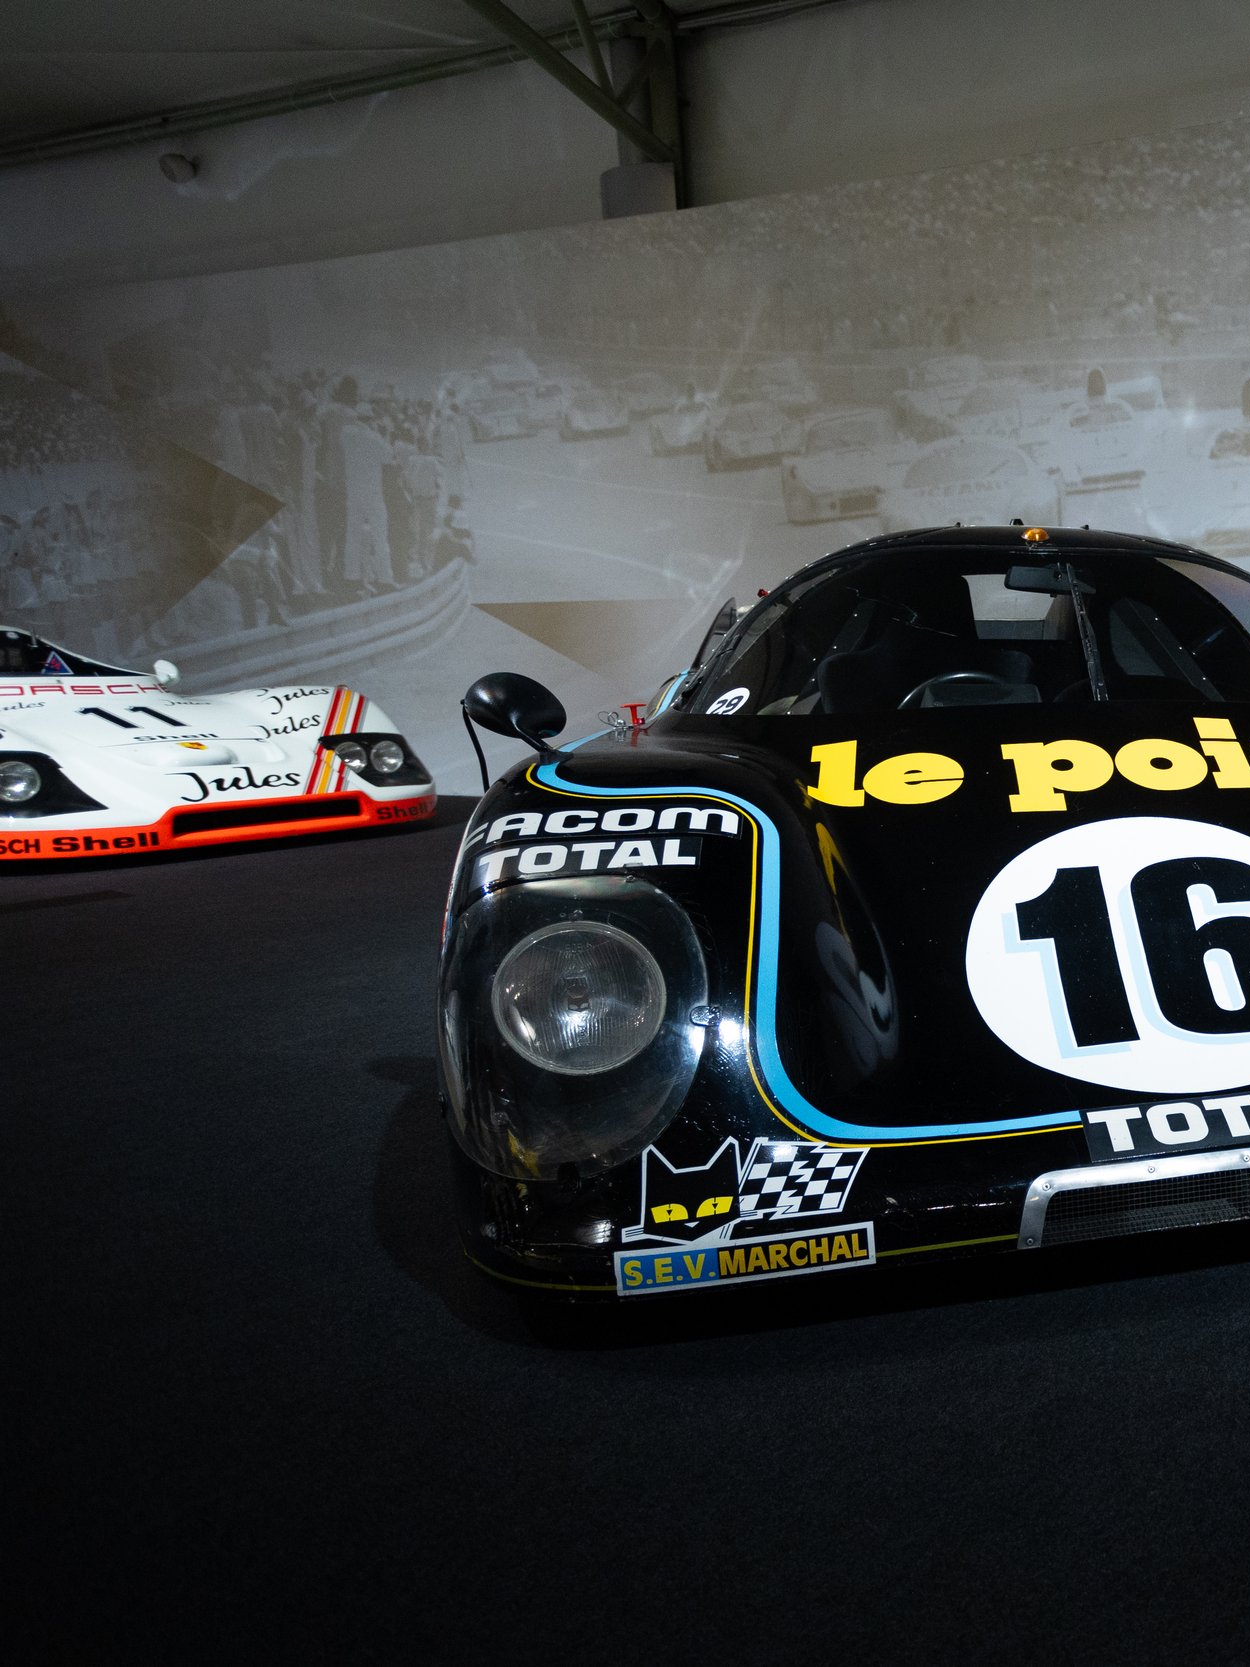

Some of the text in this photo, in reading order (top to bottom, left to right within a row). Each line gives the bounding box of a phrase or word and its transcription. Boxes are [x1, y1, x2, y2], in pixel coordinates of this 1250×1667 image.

[0, 684, 170, 696] ORSCHE
[264, 688, 330, 715] Jules
[0, 701, 46, 712] ules
[76, 706, 190, 729] 11
[252, 714, 321, 739] Jules
[165, 767, 302, 802] Jules
[807, 740, 964, 807] le
[52, 832, 160, 852] Shell
[479, 839, 697, 885] TOTAL
[718, 1232, 867, 1275] MARCHAL
